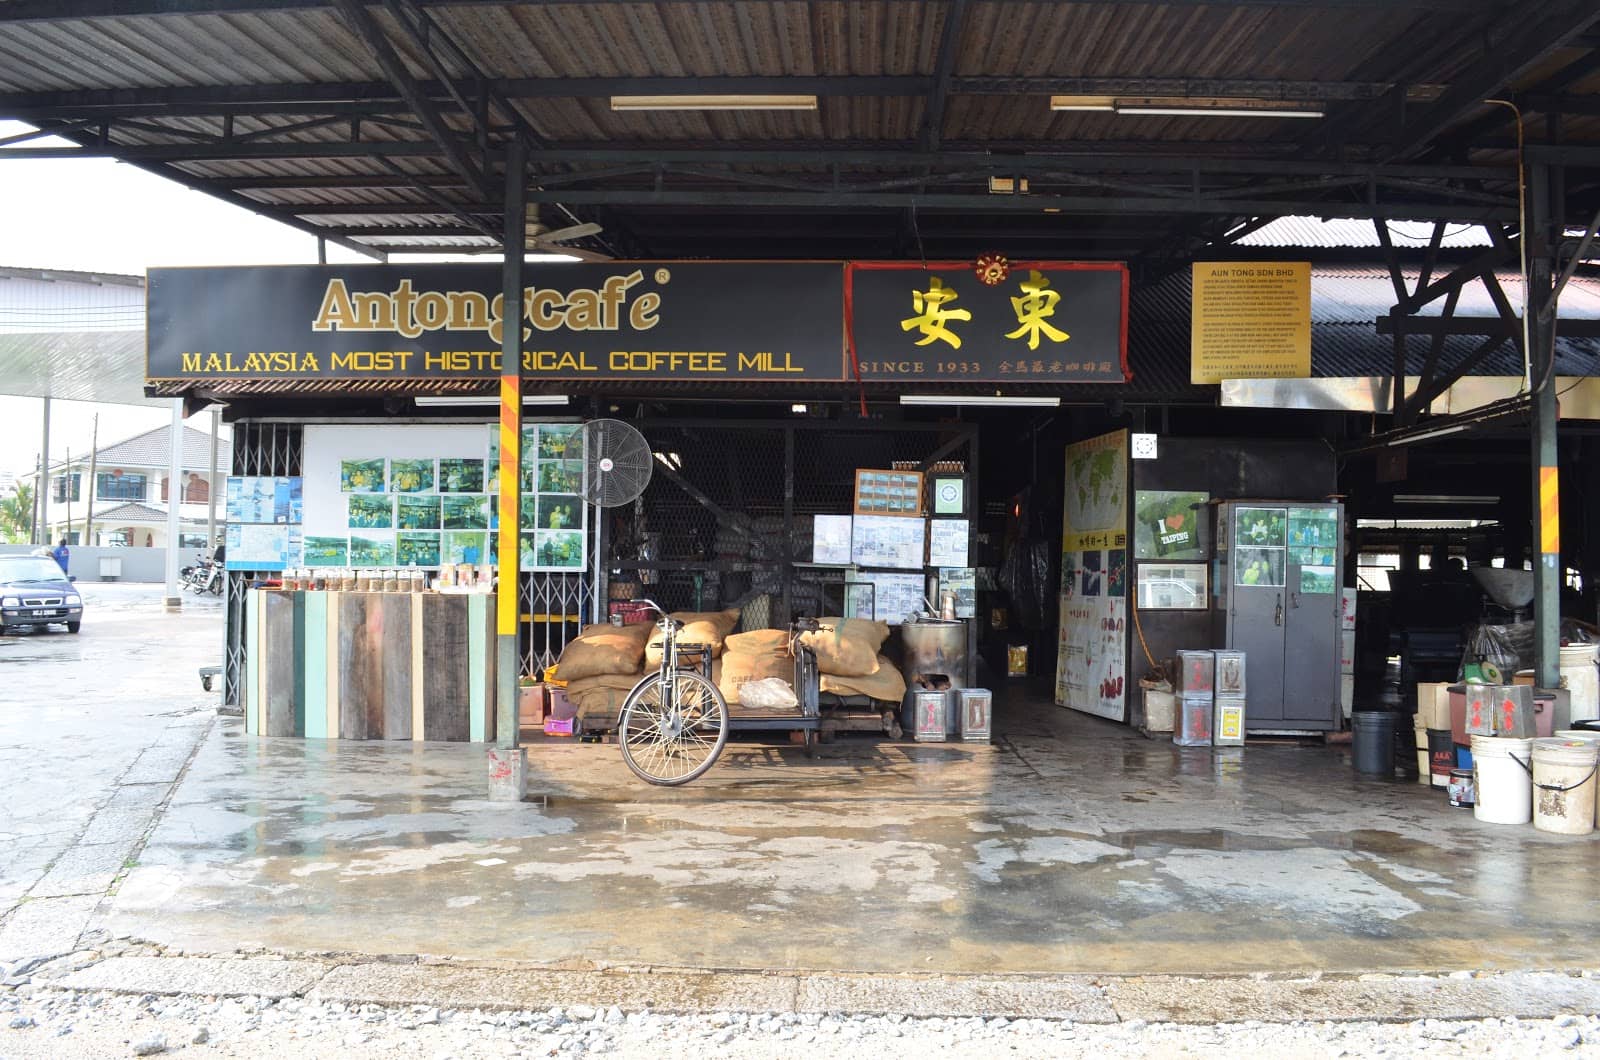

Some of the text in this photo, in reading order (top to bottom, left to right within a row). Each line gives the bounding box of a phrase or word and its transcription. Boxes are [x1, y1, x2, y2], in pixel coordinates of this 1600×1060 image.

[1211, 269, 1294, 277] AUN TONG SDN BHD
[901, 269, 1071, 350] 安東
[181, 352, 320, 372] MALAYSIA
[331, 352, 413, 371] MOST
[609, 352, 727, 372] COFFEE
[738, 352, 804, 372] MILL
[859, 361, 982, 374] SINCE 1933
